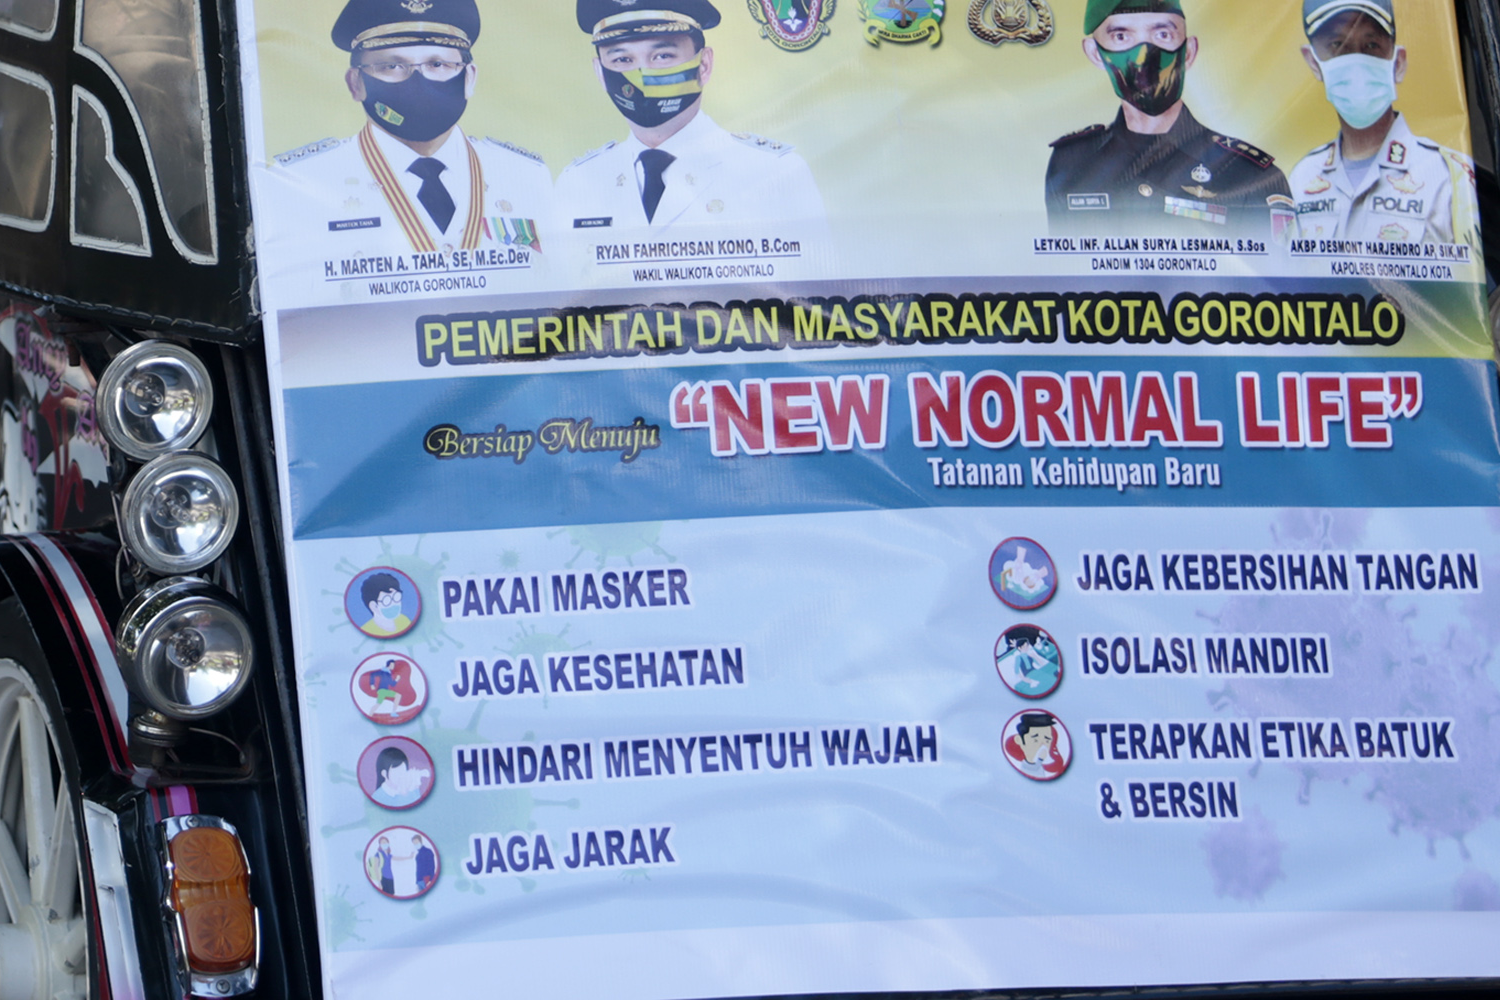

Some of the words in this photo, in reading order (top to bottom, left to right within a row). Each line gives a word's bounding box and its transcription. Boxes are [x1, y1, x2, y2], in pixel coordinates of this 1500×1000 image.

[1372, 196, 1424, 214] POLRI
[324, 261, 337, 277] H.
[341, 257, 393, 276] MARTEN
[397, 255, 408, 272] A.
[412, 252, 449, 272] TAHA,
[452, 250, 473, 270] SE,
[475, 248, 531, 266] M.Ec.Dev
[596, 244, 630, 261] RYAN
[633, 241, 714, 259] FAHRICHSAN
[718, 240, 758, 257] KONO,
[761, 238, 801, 253] B.Com
[1034, 238, 1076, 251] LETKOL
[1080, 238, 1100, 251] INF.
[1104, 238, 1139, 251] ALLAN
[1143, 239, 1177, 251] SURYA
[1181, 239, 1234, 254] LESMANA,
[1237, 240, 1265, 252] S.Sos
[1092, 258, 1131, 271] DANDIM
[1134, 258, 1155, 271] 1304
[1158, 258, 1217, 271] GORONTALO
[1291, 239, 1317, 253] AKBP
[1320, 240, 1362, 255] DESMONT
[1366, 241, 1421, 257] HARJENDRO
[369, 279, 422, 296] WALIKOTA
[423, 275, 487, 292] GORONTALO
[633, 268, 663, 282] WAKIL
[664, 266, 714, 281] WALIKOTA
[715, 263, 774, 278] GORONTALO
[1331, 261, 1376, 276] KAPOLRES
[1377, 263, 1428, 278] GORONTALO
[1430, 264, 1453, 279] KOTA
[424, 311, 684, 360] PEMERINTAH
[696, 305, 781, 346] DAN
[793, 298, 1057, 343] MASYARAKAT
[1068, 299, 1166, 338] KOTA
[1173, 299, 1400, 340] GORONTALO
[673, 376, 888, 454] “NEW
[910, 373, 1222, 446] NORMAL
[1239, 374, 1421, 446] LIFE”
[425, 426, 533, 460] Bersiap
[539, 418, 660, 463] Menuju
[927, 457, 1024, 486] Tatanan
[1031, 457, 1159, 491] Kehidupan
[1166, 457, 1221, 486] Baru
[1077, 553, 1154, 591] JAGA
[1161, 553, 1349, 591] KEBERSIHAN
[1356, 553, 1479, 590] TANGAN
[442, 576, 541, 618] PAKAI
[551, 568, 691, 613] MASKER
[451, 658, 540, 698] JAGA
[548, 647, 744, 693] KESEHATAN
[1081, 636, 1197, 675] ISOLASI
[1205, 637, 1329, 674] MANDIRI
[457, 742, 594, 787] HINDARI
[604, 731, 813, 779] MENYENTUH
[820, 724, 938, 767] WAJAH
[1089, 722, 1252, 760] TERAPKAN
[1262, 721, 1349, 758] ETIKA
[1355, 721, 1454, 758] BATUK
[1099, 782, 1122, 818] &
[1128, 781, 1239, 818] BERSIN
[465, 834, 554, 875] JAGA
[563, 826, 675, 870] JARAK
